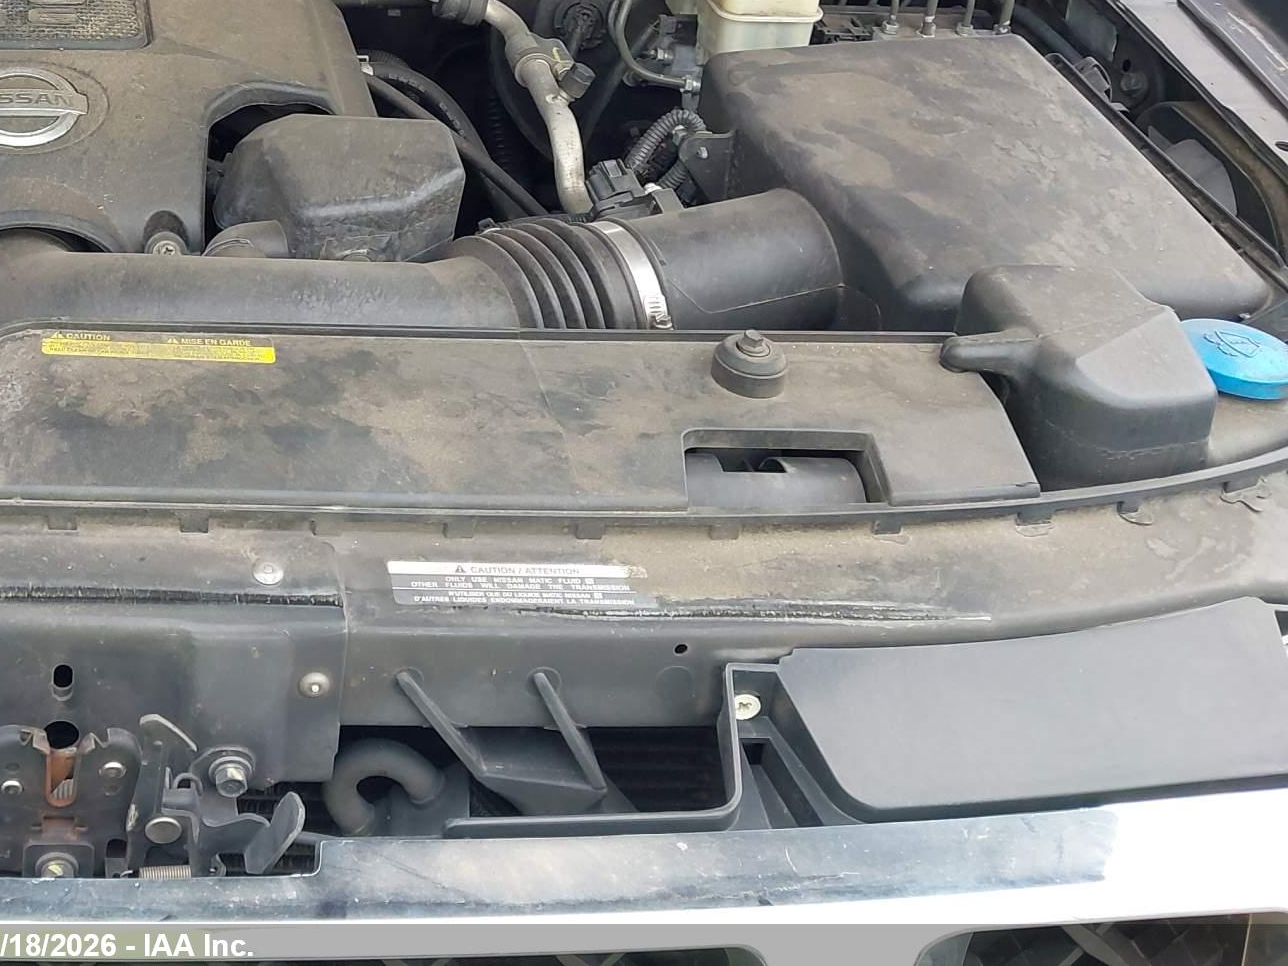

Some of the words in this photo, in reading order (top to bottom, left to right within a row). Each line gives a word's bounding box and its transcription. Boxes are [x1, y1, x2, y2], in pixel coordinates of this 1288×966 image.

[66, 333, 111, 341] CAUTION
[181, 337, 203, 345] MISE
[470, 566, 516, 574] CAUTION
[525, 567, 580, 575] ATTENTION
